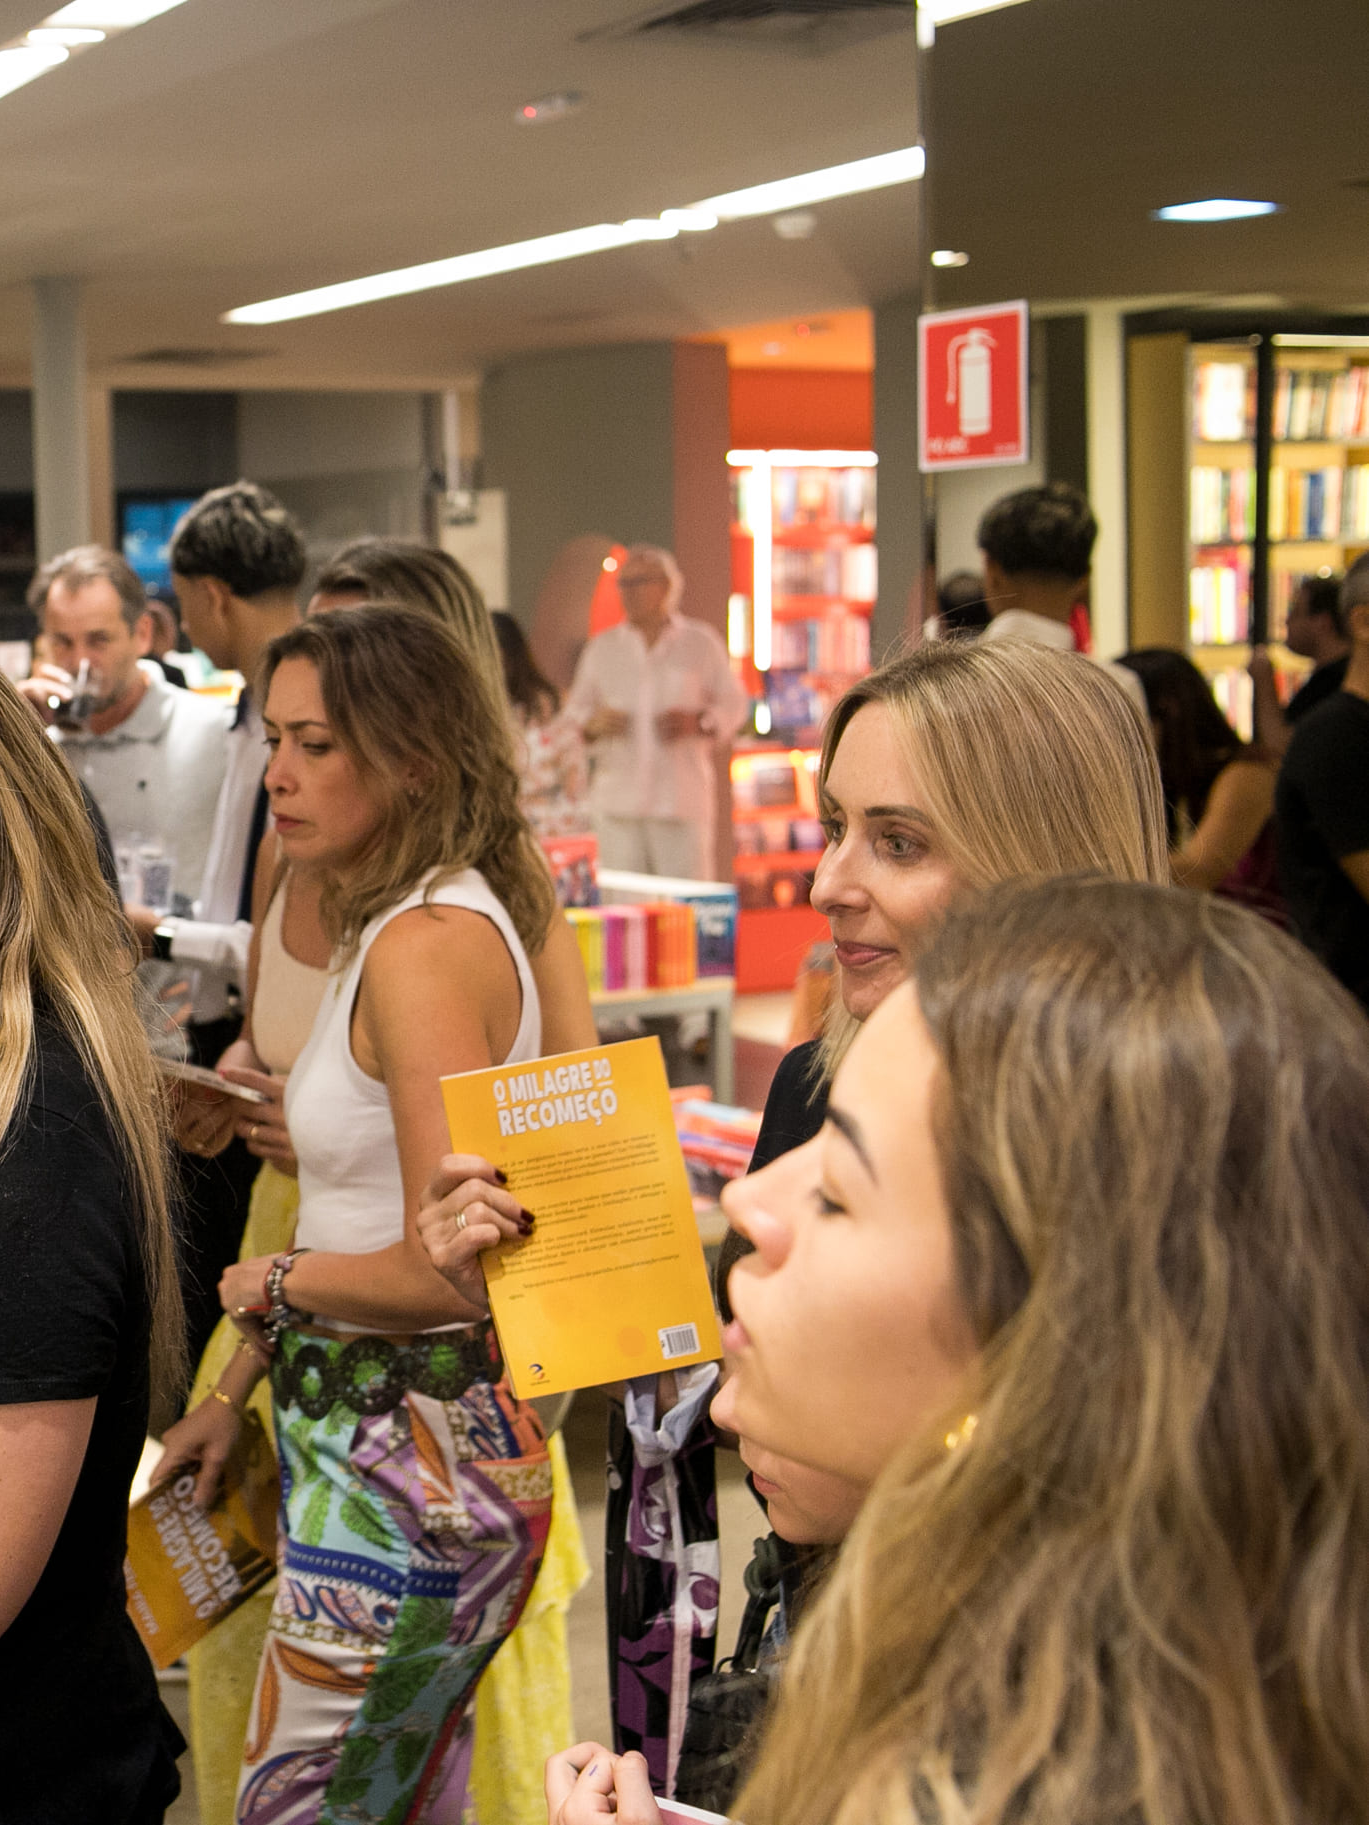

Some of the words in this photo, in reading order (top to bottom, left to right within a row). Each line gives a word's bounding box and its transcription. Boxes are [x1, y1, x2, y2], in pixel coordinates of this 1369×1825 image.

[493, 1079, 506, 1102] O
[508, 1061, 593, 1103] MILAGRE
[593, 1057, 612, 1080] DO
[498, 1087, 618, 1137] RECOMEÇO
[156, 1512, 212, 1606] MILAGRE
